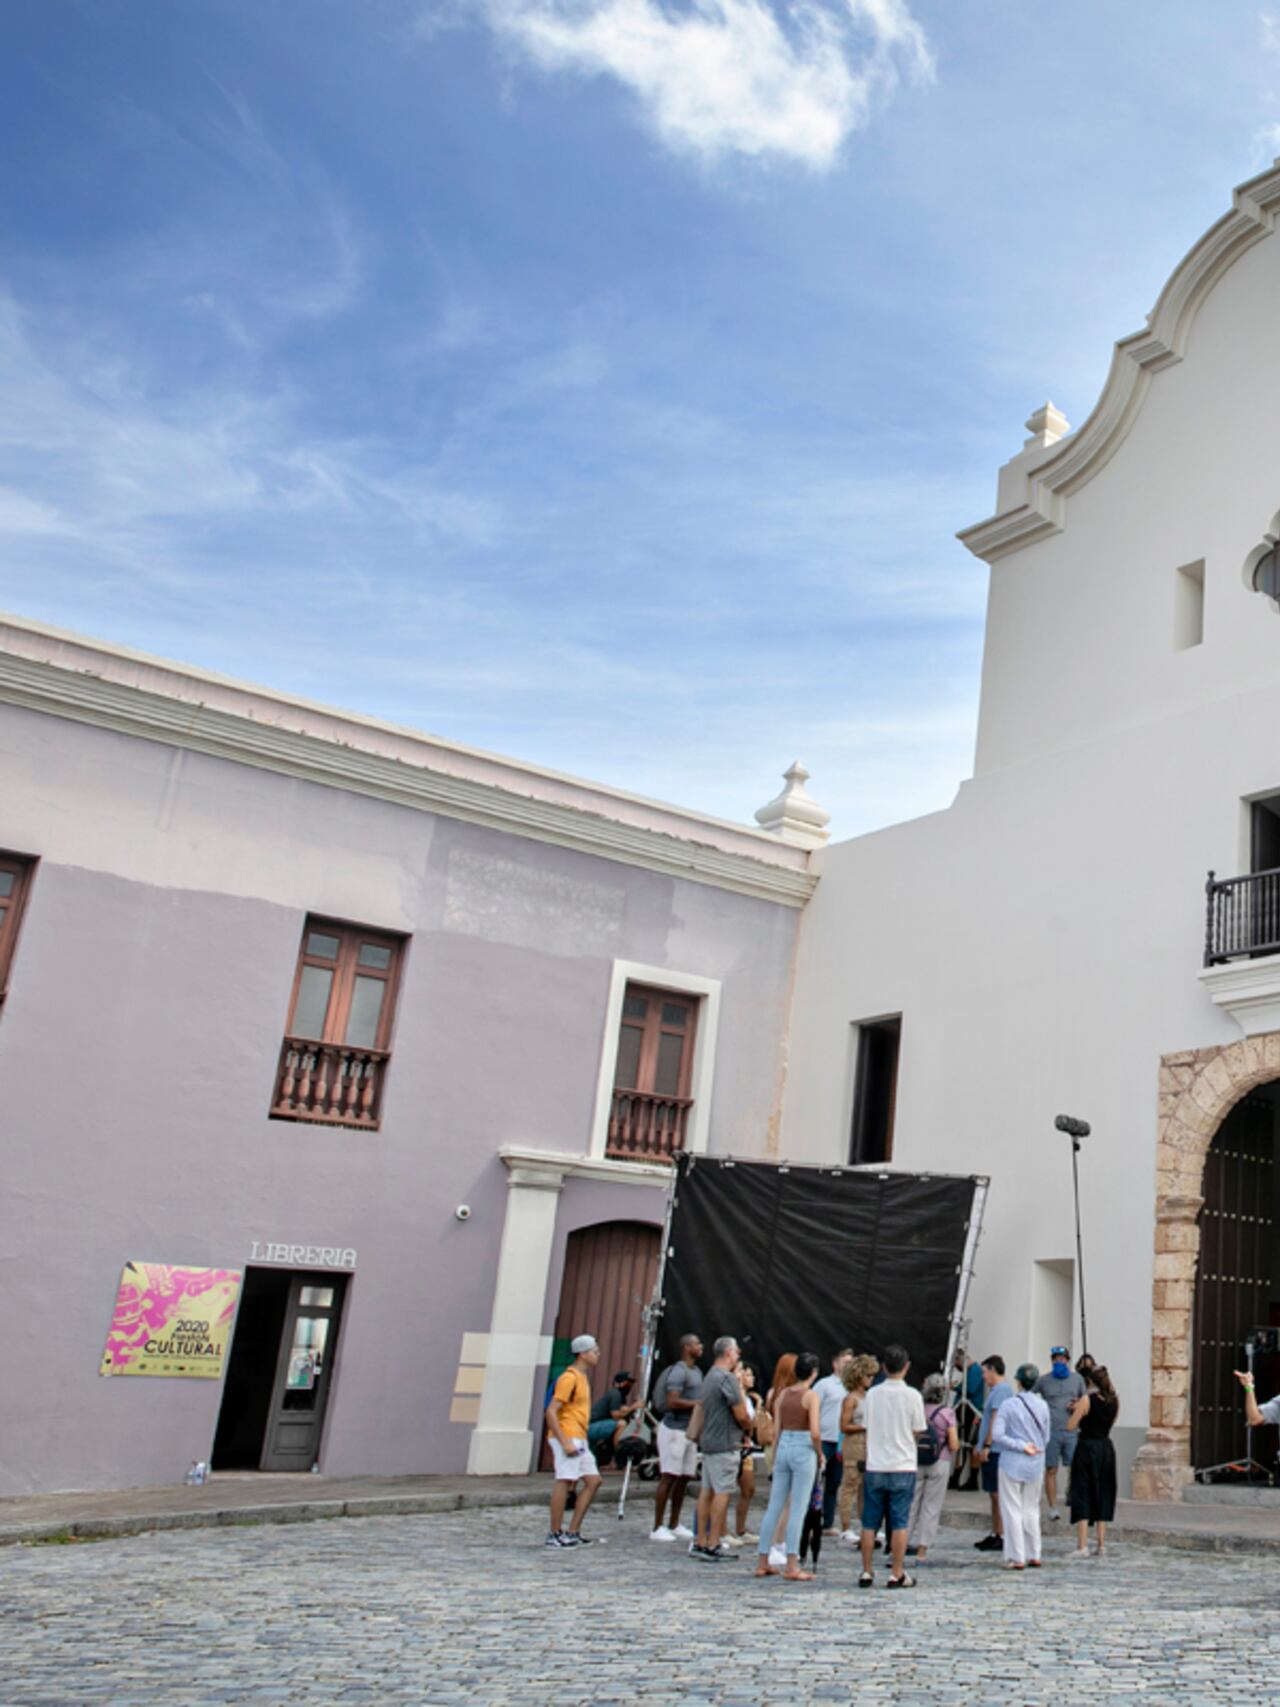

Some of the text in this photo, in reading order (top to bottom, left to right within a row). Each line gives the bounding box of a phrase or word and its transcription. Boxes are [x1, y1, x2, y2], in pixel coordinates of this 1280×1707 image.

[250, 1241, 357, 1268] LIBRERIA
[175, 1319, 210, 1333] 2020
[144, 1340, 222, 1355] CULTURAL
